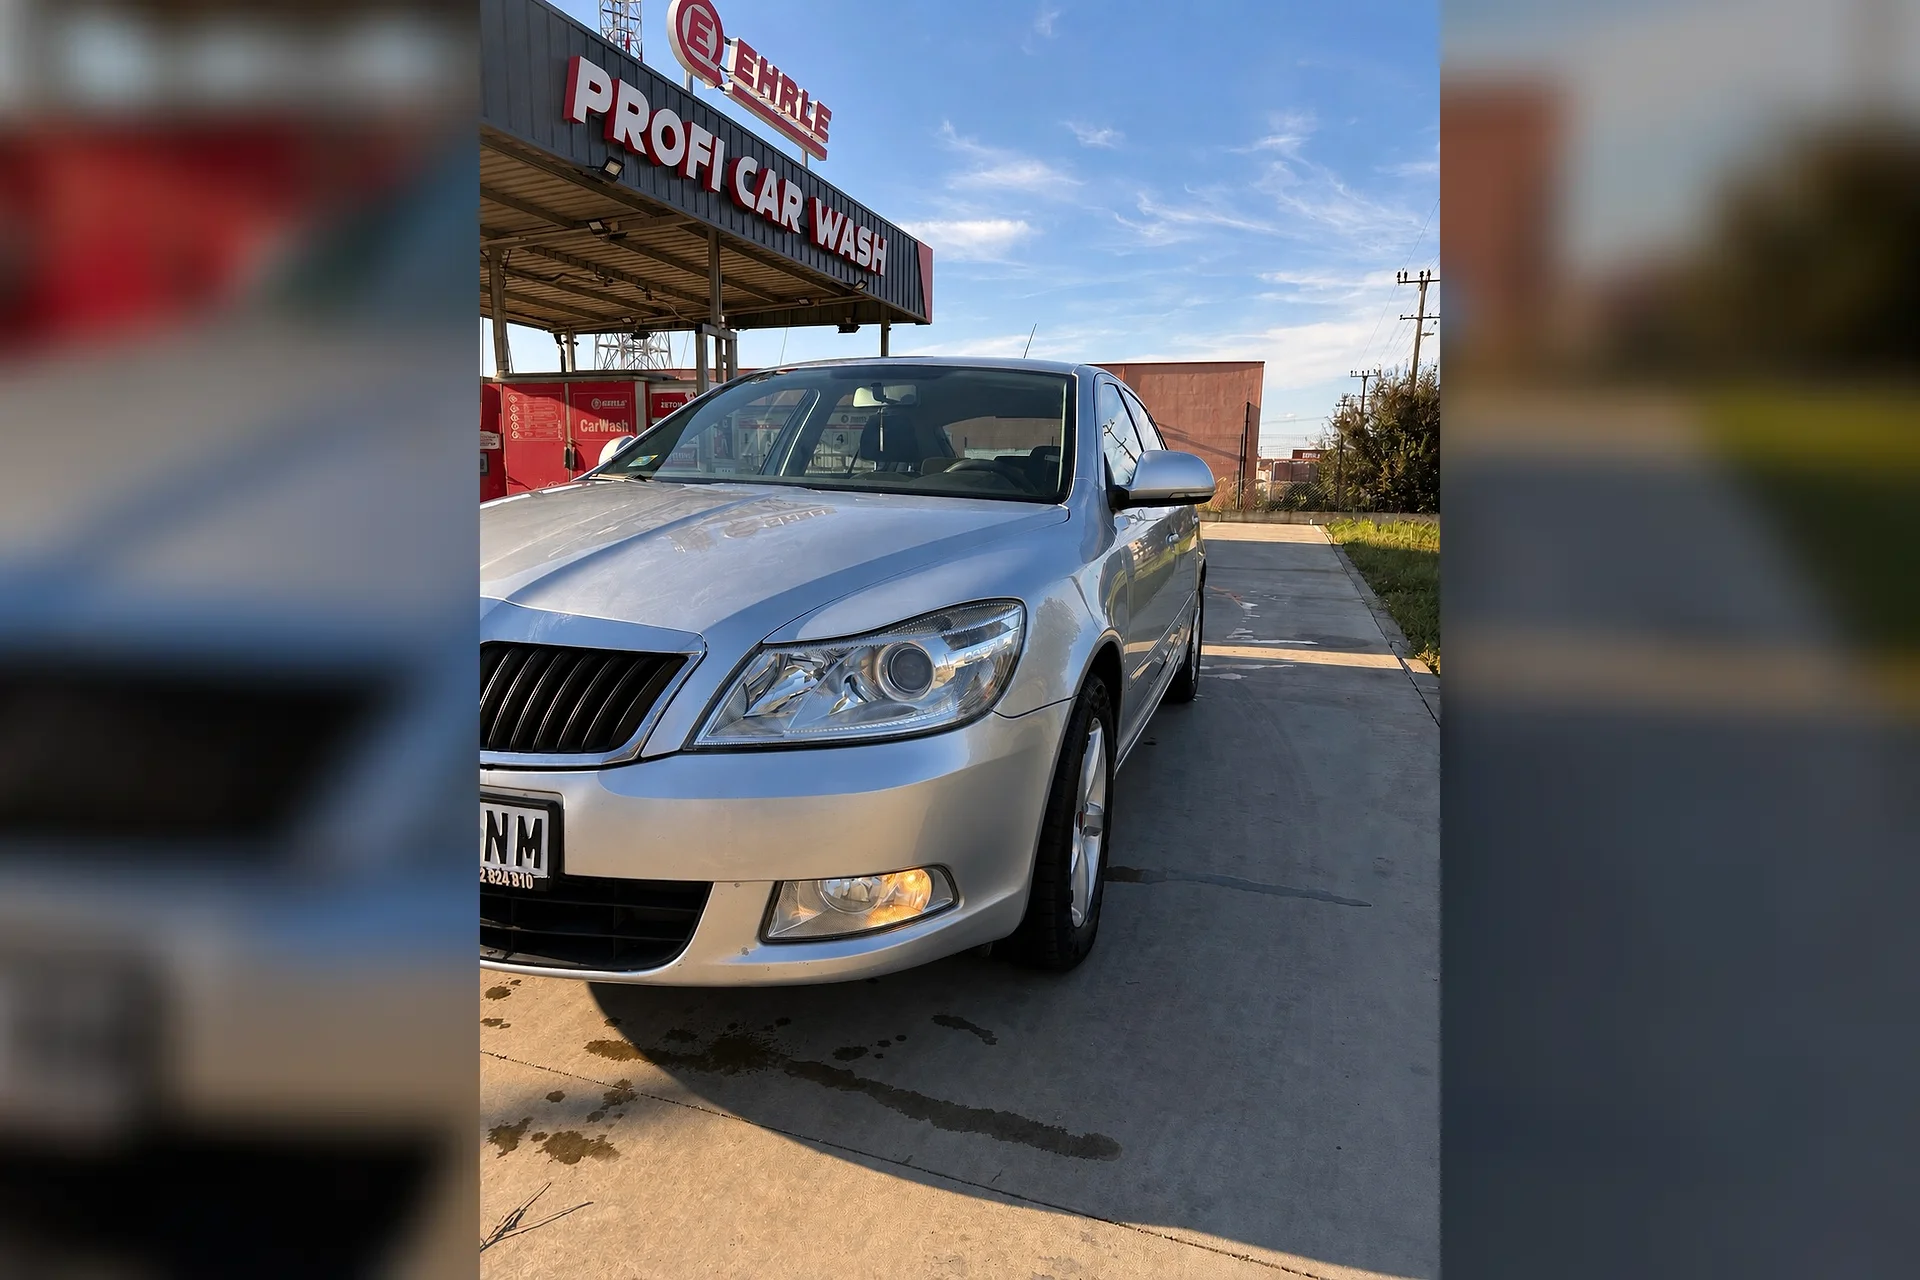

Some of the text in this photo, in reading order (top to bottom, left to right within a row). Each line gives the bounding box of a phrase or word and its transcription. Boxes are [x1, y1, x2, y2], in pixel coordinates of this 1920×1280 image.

[733, 38, 832, 143] EHRLE
[563, 55, 888, 276] PROFI CAR WASH
[580, 419, 629, 433] CarWash
